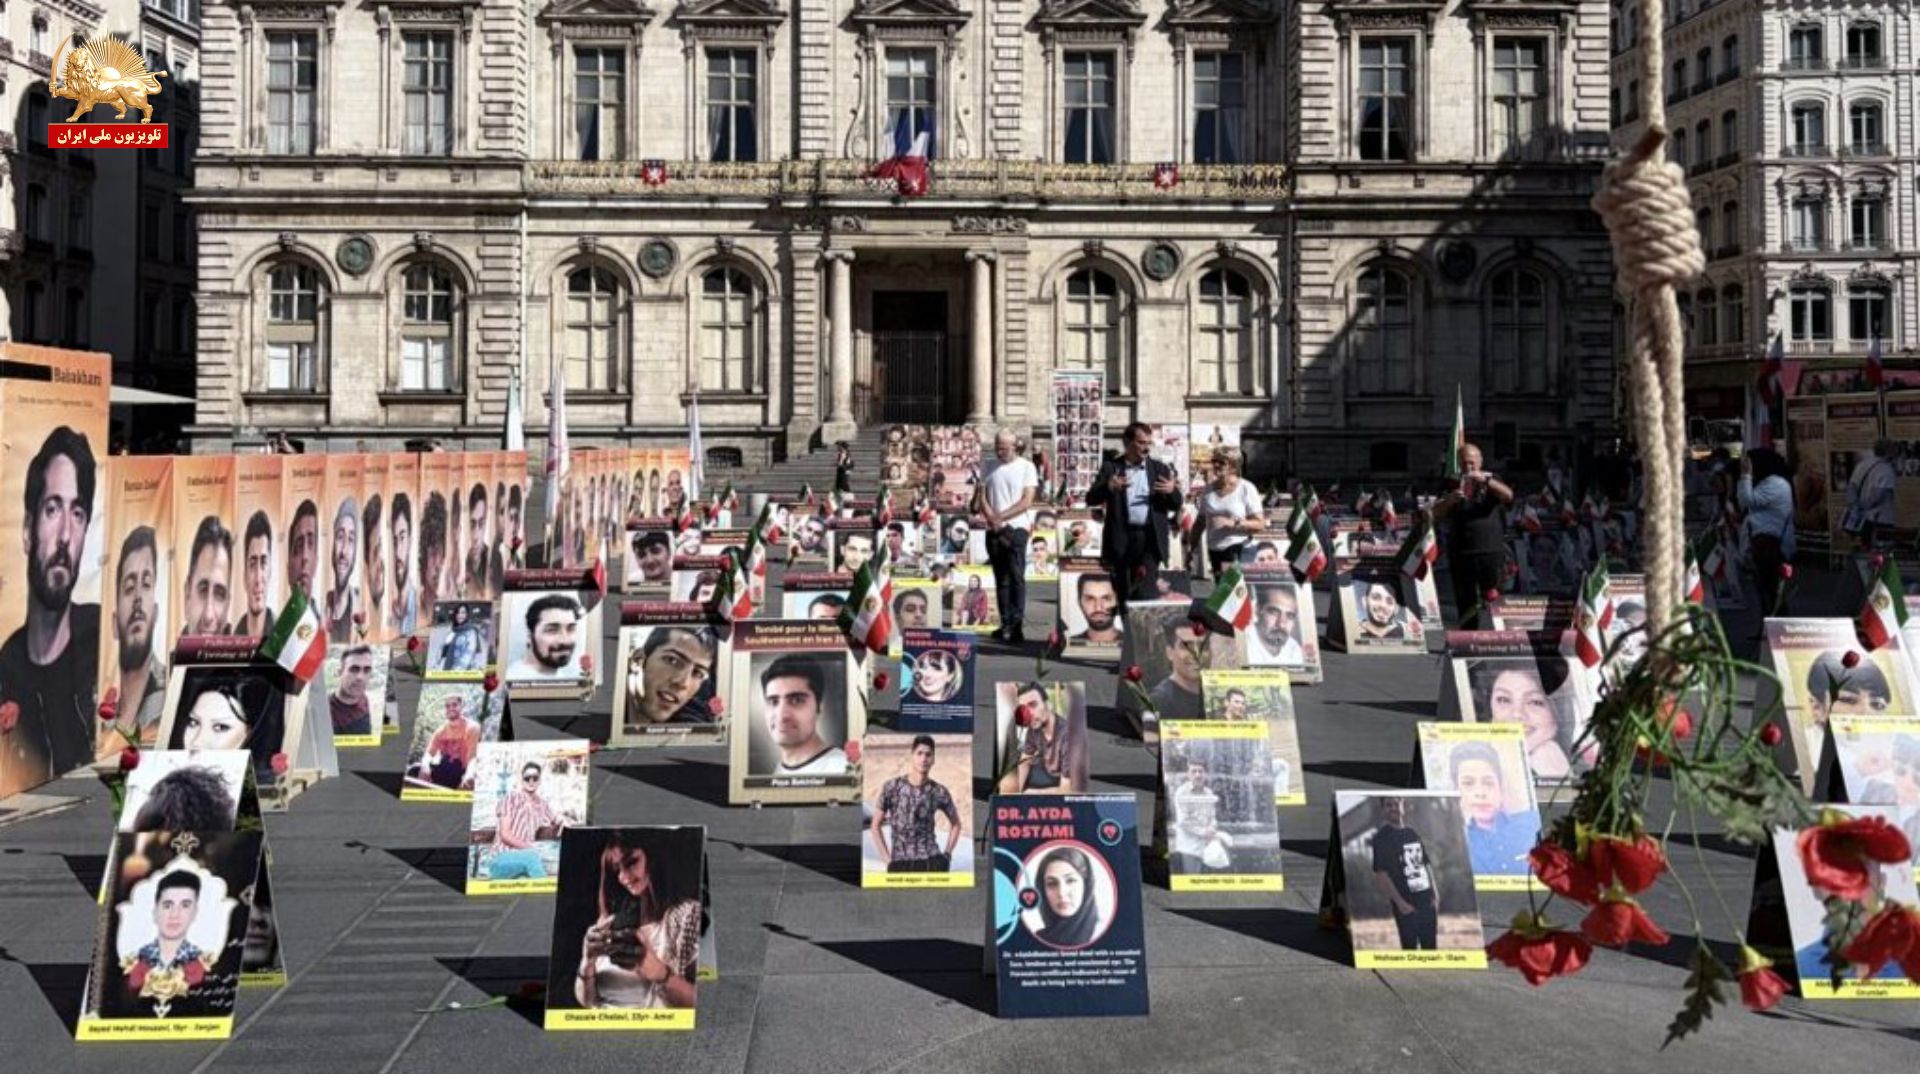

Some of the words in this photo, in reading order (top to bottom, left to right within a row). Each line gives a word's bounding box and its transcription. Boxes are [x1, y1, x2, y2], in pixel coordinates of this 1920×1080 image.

[785, 626, 806, 636] pour
[996, 807, 1024, 820] DR.
[1027, 807, 1073, 820] AYDA
[997, 824, 1075, 838] ROSTAMI
